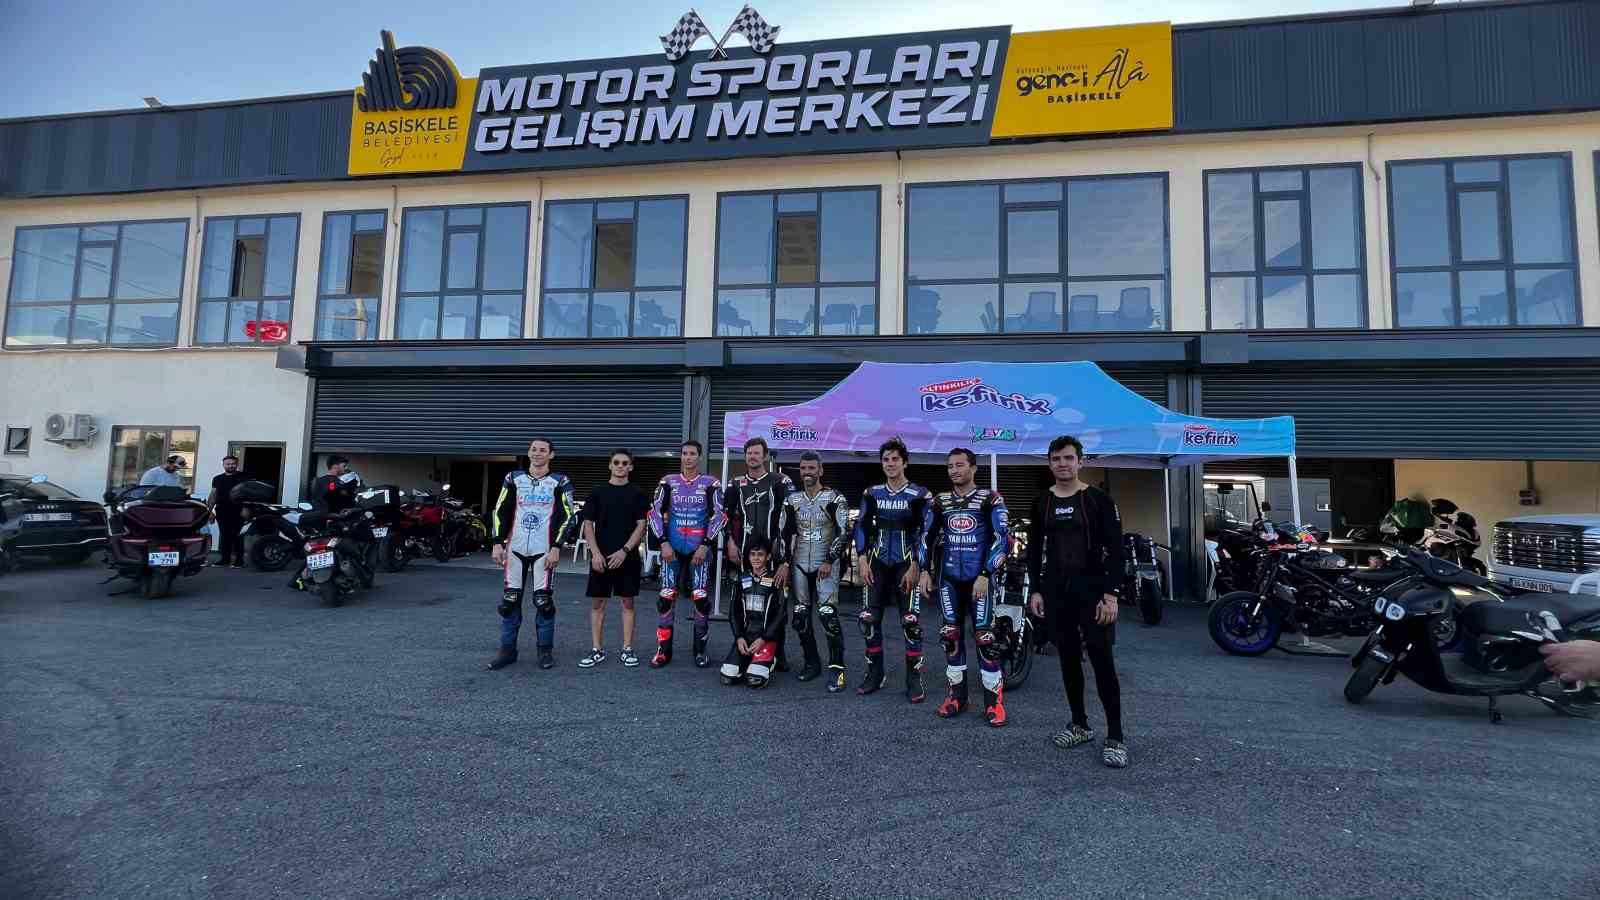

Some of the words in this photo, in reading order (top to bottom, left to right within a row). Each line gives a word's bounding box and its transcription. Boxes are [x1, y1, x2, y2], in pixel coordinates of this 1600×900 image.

[477, 65, 676, 113] MOTOR
[686, 39, 999, 97] SPORLARI
[1047, 92, 1121, 103] BAŞİSKELE
[364, 116, 458, 135] BAŞİSKELE
[474, 104, 696, 152] GELİŞİM
[706, 84, 989, 137] MERKEZİ
[920, 384, 1054, 415] kefirix
[771, 425, 818, 441] kefirix
[1184, 430, 1239, 447] kefirix
[876, 499, 909, 510] YAMAHA
[948, 534, 977, 544] YAMAHA
